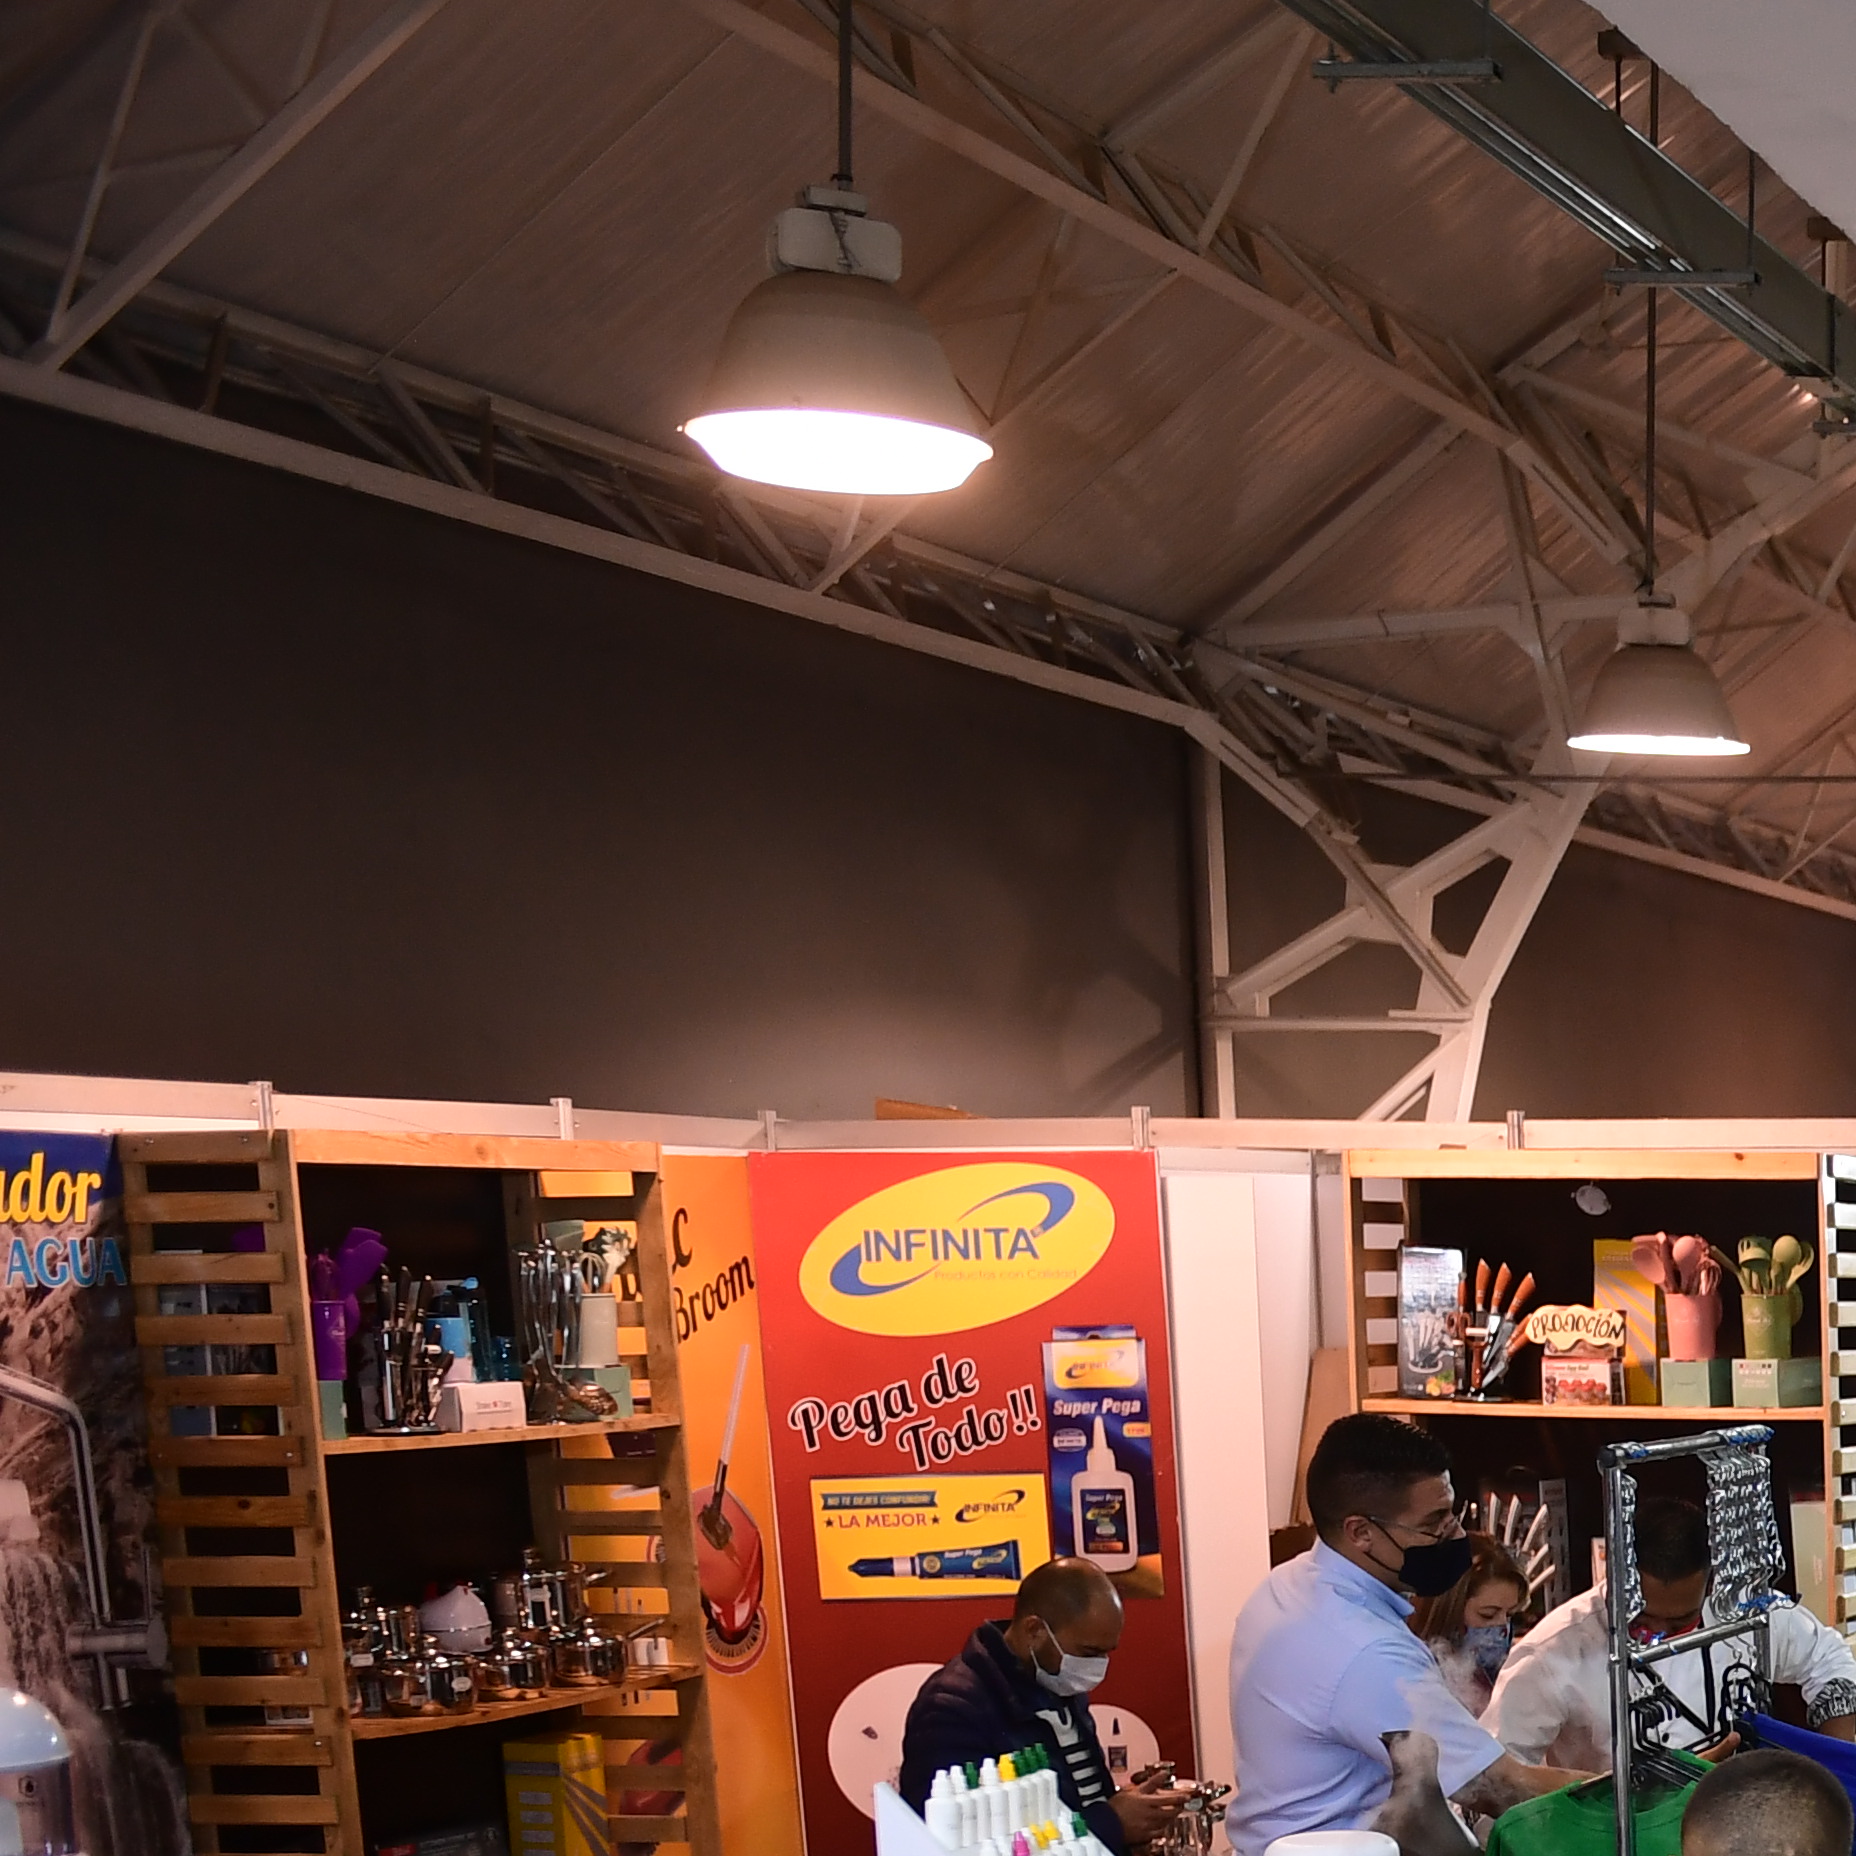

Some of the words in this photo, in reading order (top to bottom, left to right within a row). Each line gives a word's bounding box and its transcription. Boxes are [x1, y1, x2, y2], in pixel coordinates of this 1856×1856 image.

[861, 1227, 1040, 1262] INFINITA
[6, 1237, 127, 1288] AGUA
[788, 1379, 914, 1453] Pega
[922, 1353, 979, 1404] de
[1053, 1398, 1098, 1418] Super
[1102, 1397, 1141, 1417] Pega
[838, 1515, 861, 1529] LA
[865, 1513, 928, 1528] MEJOR
[964, 1503, 1016, 1514] INFINITA
